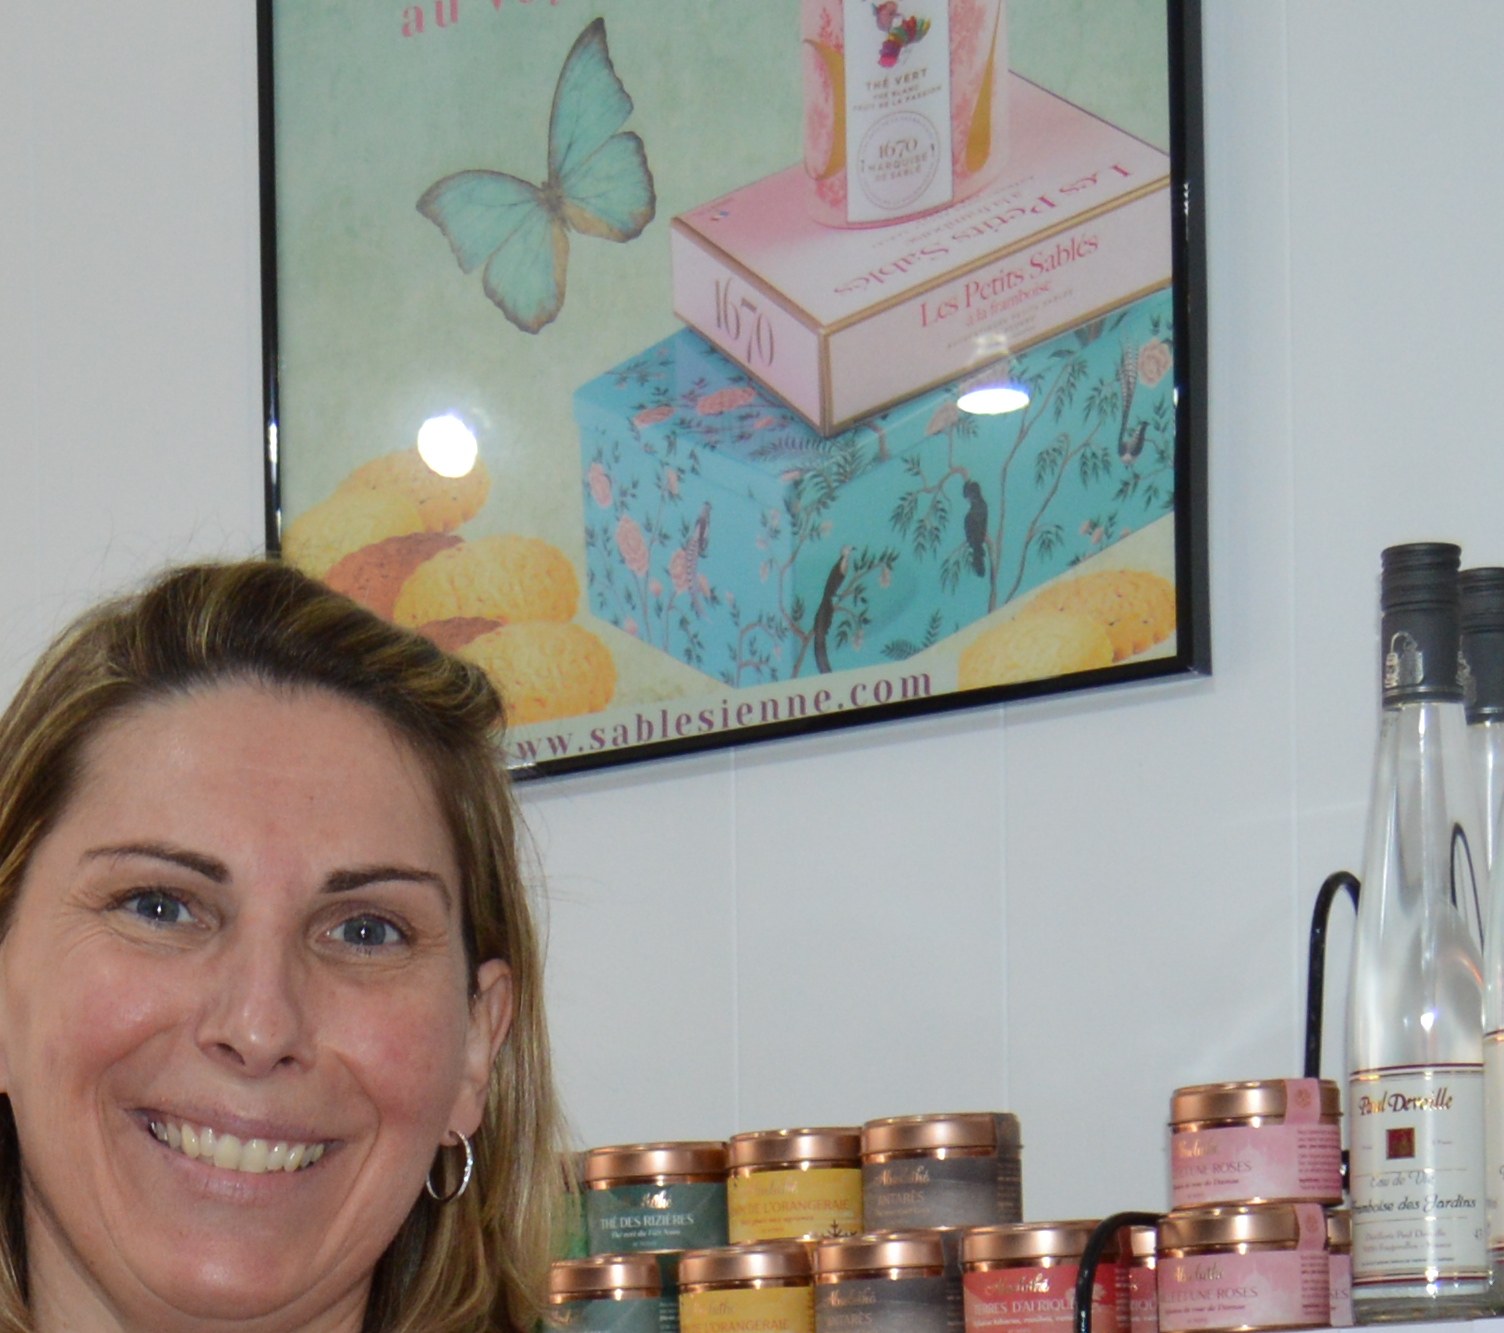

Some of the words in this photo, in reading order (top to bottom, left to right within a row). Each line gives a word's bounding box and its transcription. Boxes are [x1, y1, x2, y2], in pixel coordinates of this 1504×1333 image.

[865, 78, 888, 91] THÉ
[895, 68, 927, 85] VERT
[868, 152, 928, 171] MARQUISE
[919, 298, 960, 328] Les
[964, 269, 1025, 308] Petits
[1029, 232, 1099, 274] Sablés
[714, 277, 775, 368] 1670
[512, 672, 932, 762] ww.sablesienne.com
[1359, 1091, 1386, 1116] Paul
[1213, 1161, 1252, 1174] ROSES
[1397, 1197, 1420, 1211] des
[1423, 1194, 1476, 1213] Jardins
[620, 1216, 641, 1227] DES
[643, 1212, 694, 1226] RIZIÈRES
[1217, 1288, 1258, 1299] ROSES
